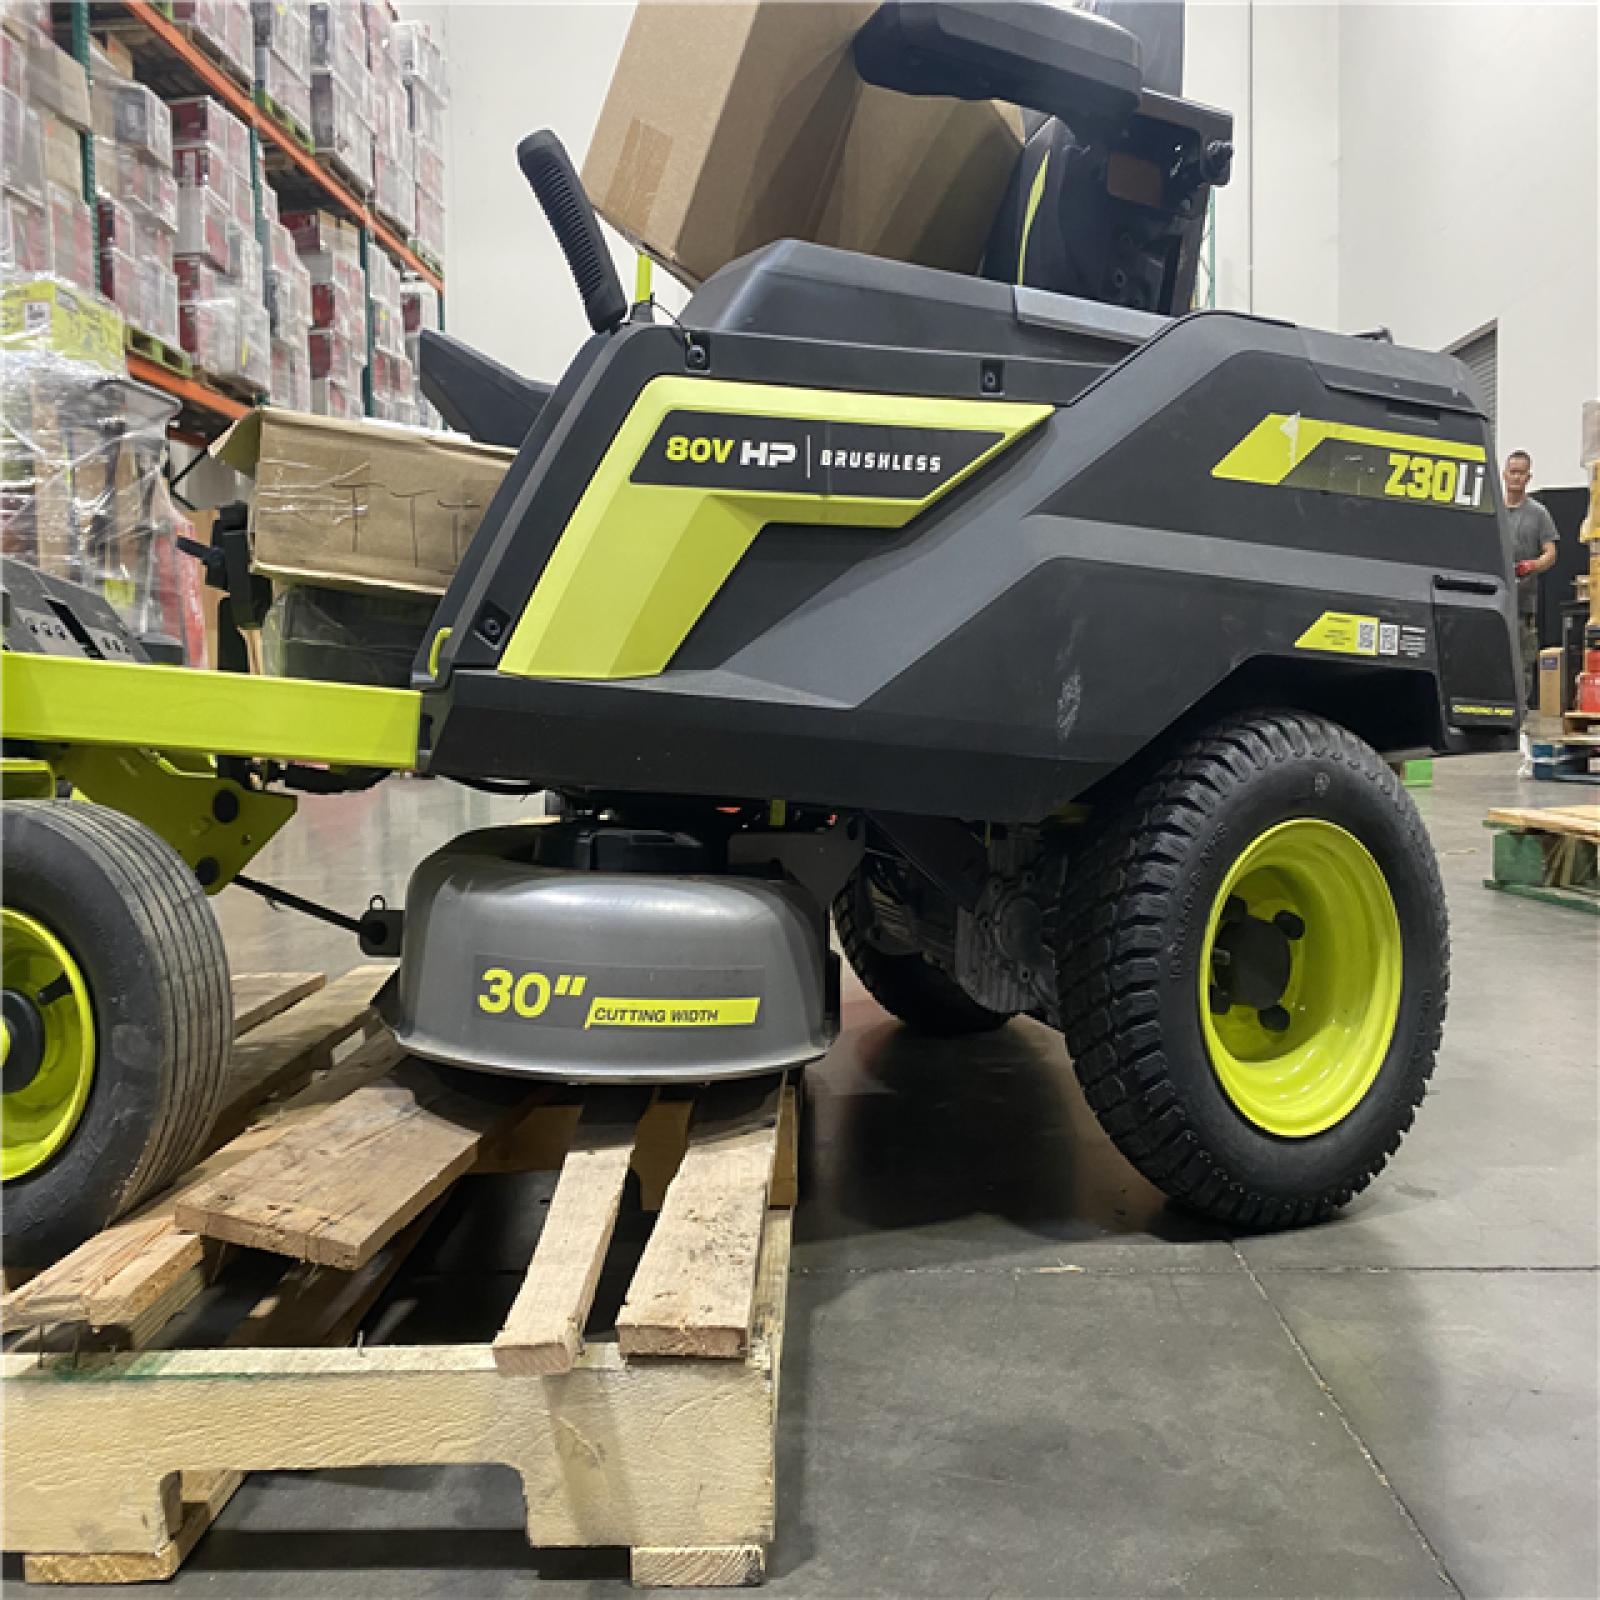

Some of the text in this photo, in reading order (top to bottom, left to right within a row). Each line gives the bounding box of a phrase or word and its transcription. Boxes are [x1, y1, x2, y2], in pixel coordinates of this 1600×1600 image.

[665, 434, 941, 473] 80V HP BRUSHLESS
[1384, 452, 1485, 507] Z30Li
[594, 1007, 719, 1023] CUTTING WIDTH
